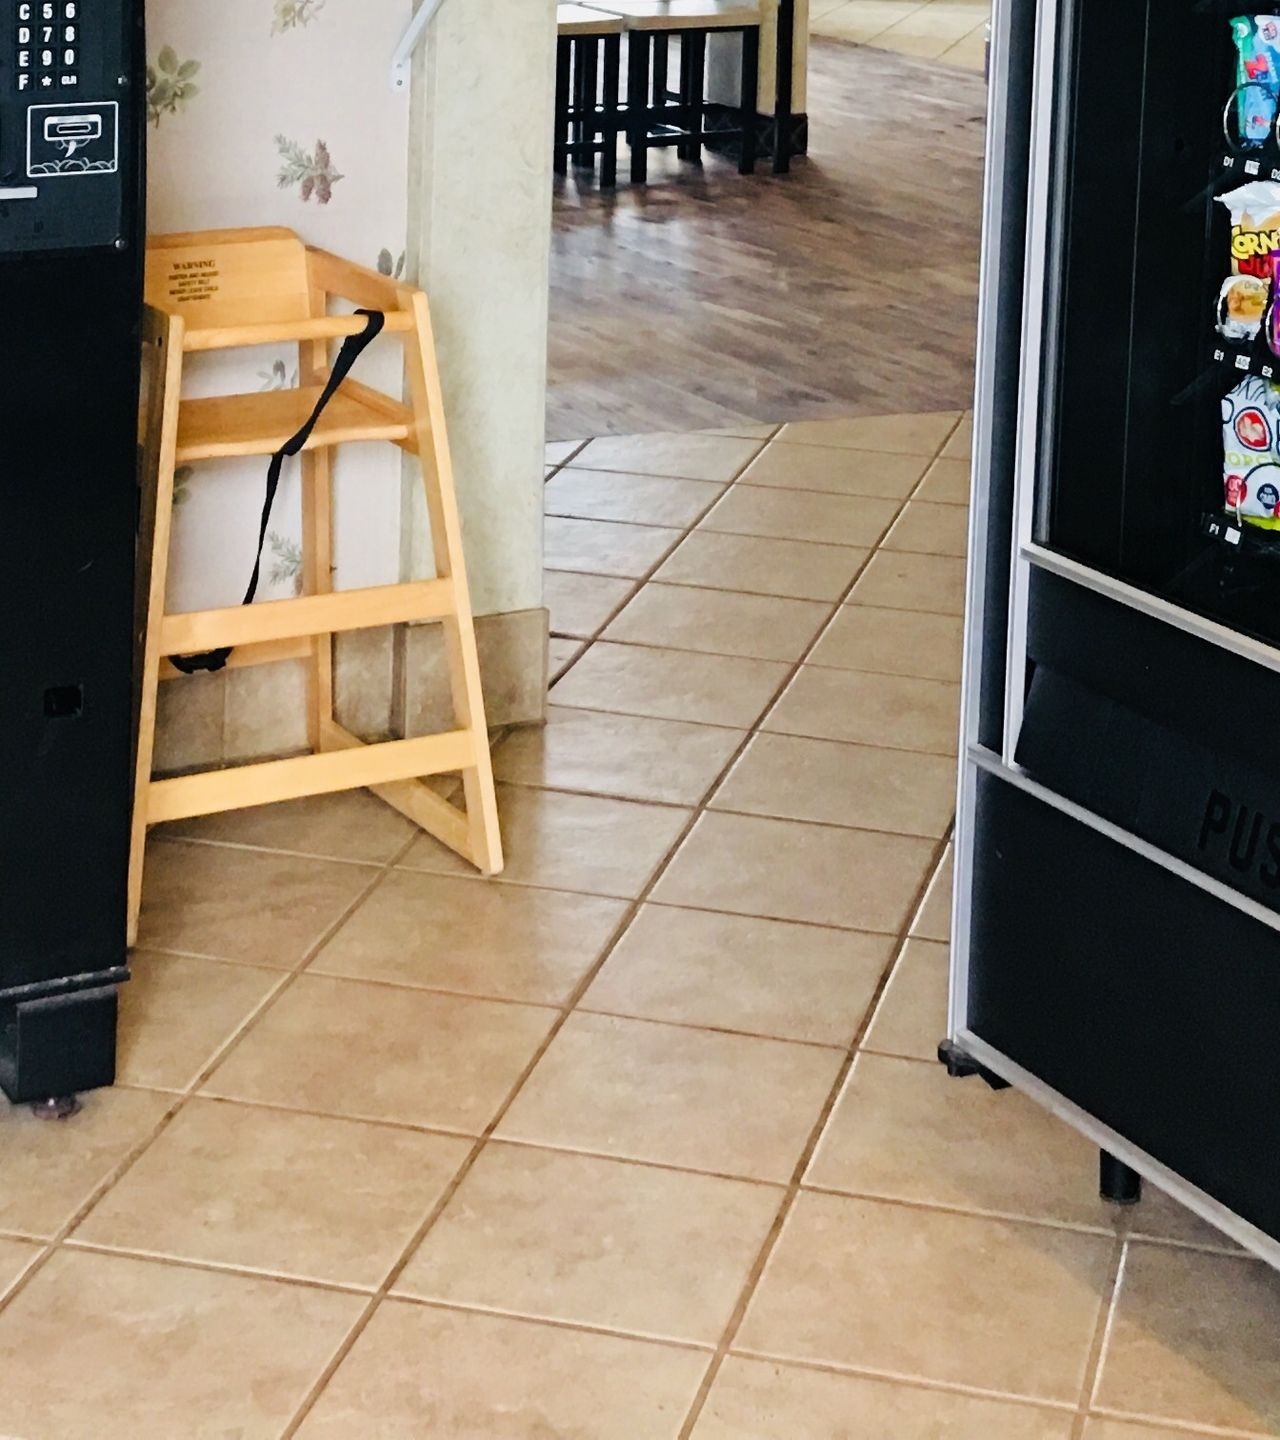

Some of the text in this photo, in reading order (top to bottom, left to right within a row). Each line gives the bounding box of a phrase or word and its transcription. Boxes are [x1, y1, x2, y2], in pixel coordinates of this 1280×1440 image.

[20, 3, 75, 20] C 5 6
[19, 26, 75, 43] D 7 8
[19, 49, 74, 66] E 9 0
[19, 74, 29, 90] F
[1223, 156, 1234, 167] D1
[173, 260, 215, 270] WARNING
